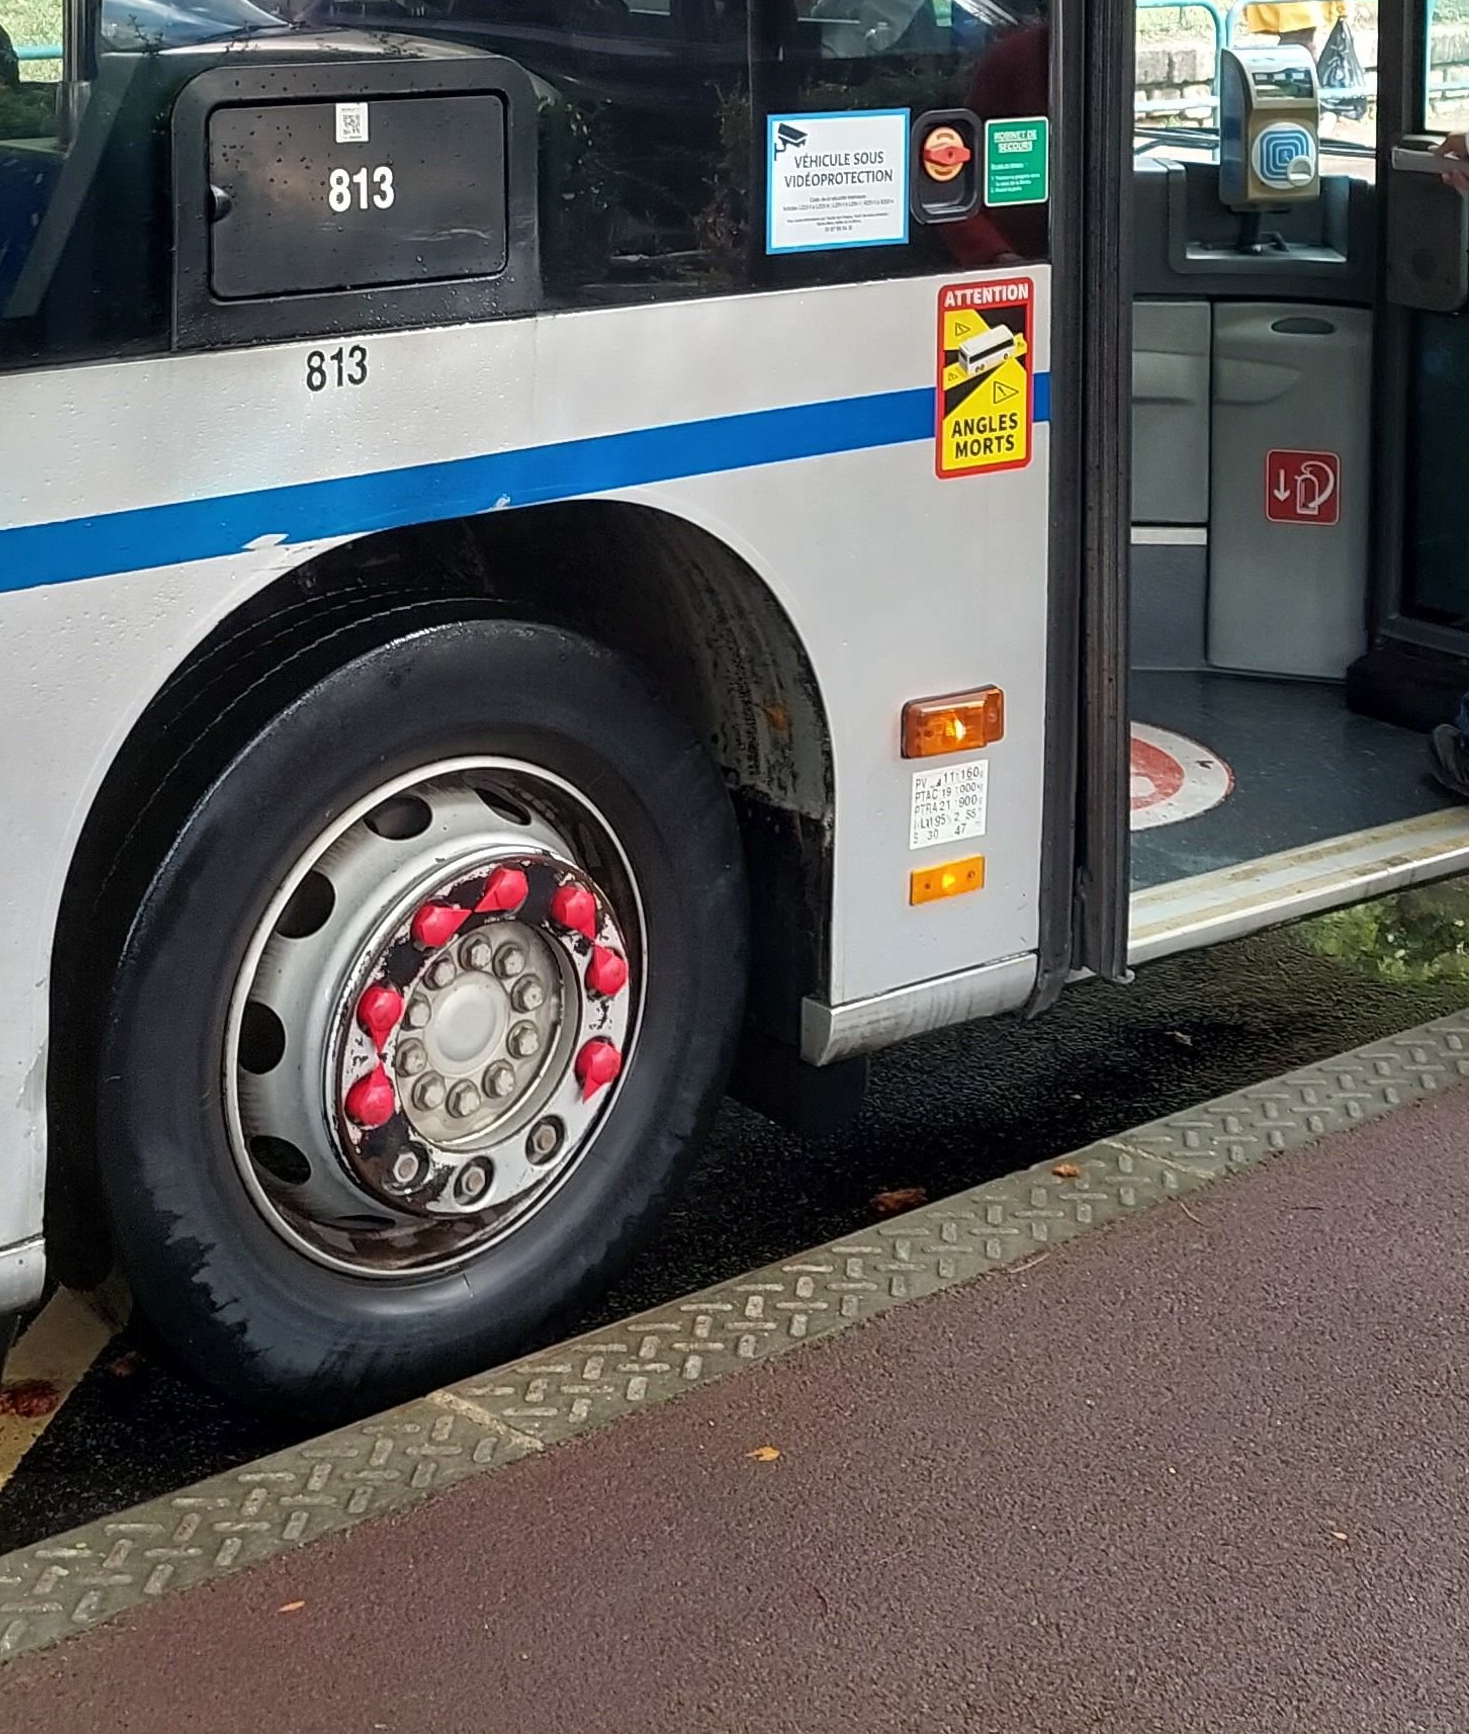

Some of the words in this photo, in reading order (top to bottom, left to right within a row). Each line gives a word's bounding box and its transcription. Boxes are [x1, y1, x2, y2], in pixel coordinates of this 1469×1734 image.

[794, 152, 851, 169] VÉHICULE
[853, 151, 885, 166] SOUS
[328, 166, 395, 212] 813
[784, 169, 893, 188] VIDÉOPROTECTION
[944, 283, 1029, 308] ATTENTION
[306, 344, 368, 392] 813
[951, 412, 1018, 438] ANGLES
[955, 434, 1015, 459] MORTS
